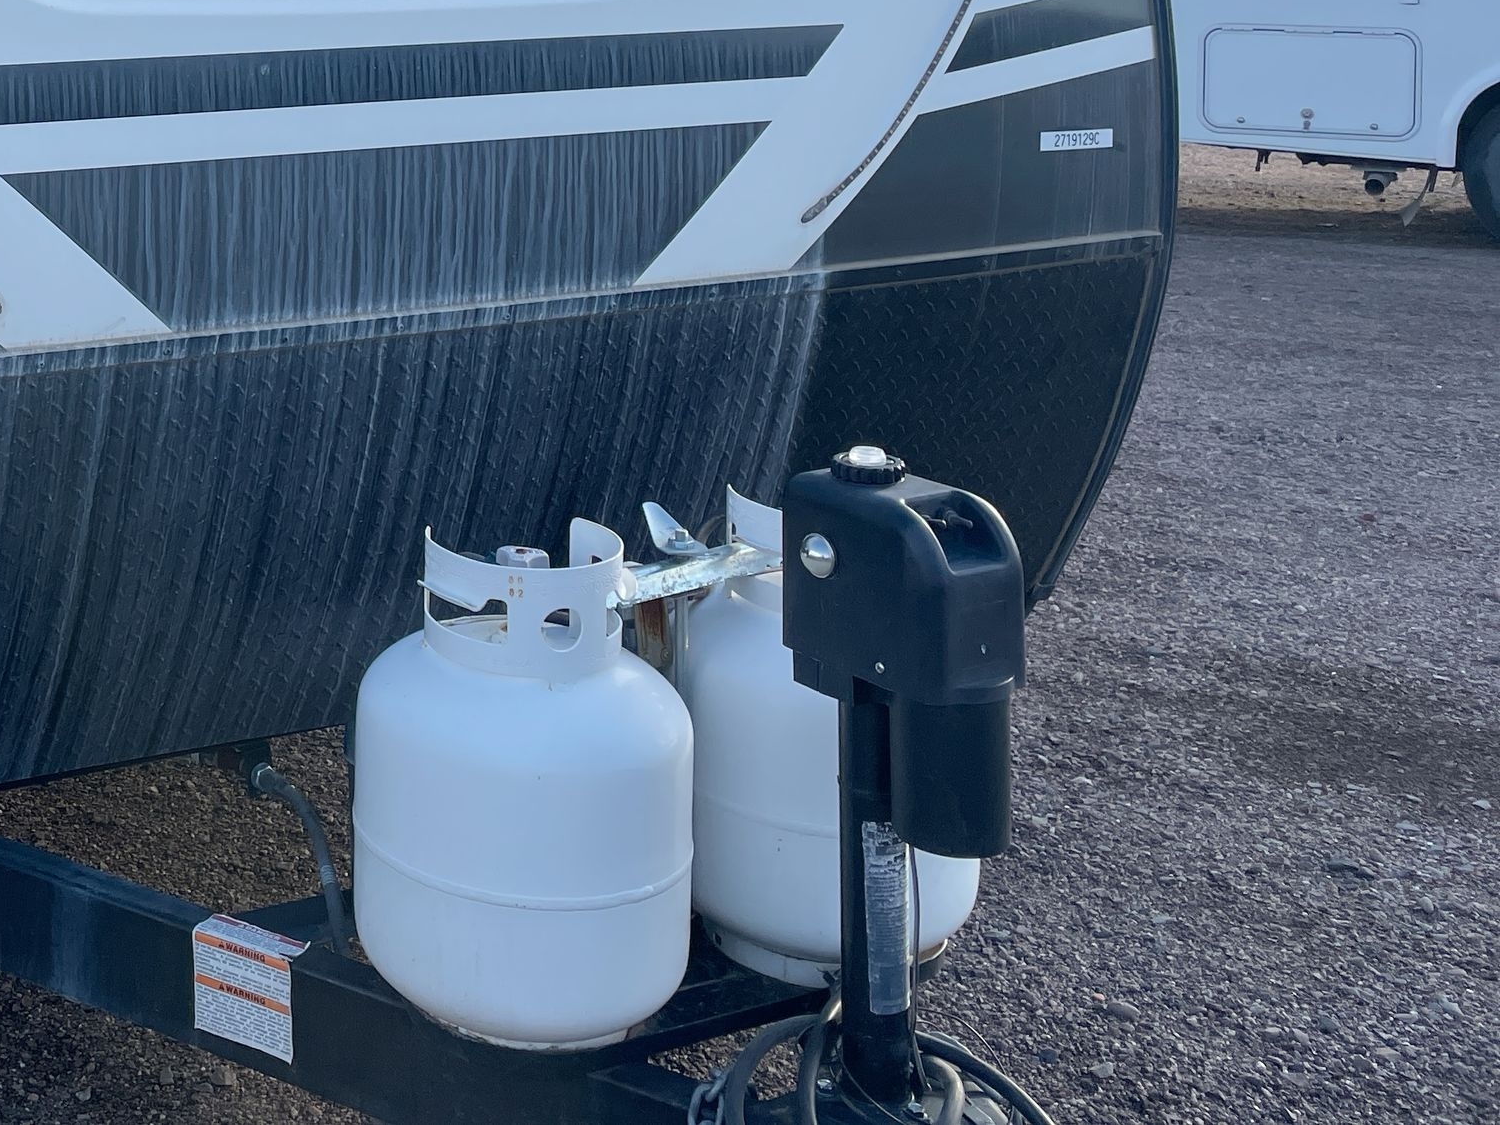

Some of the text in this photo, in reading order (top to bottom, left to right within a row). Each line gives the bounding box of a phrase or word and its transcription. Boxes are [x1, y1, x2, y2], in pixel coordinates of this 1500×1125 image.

[1054, 132, 1100, 147] 2719129C
[225, 942, 266, 963] WARNING
[225, 983, 266, 1005] WARNING
